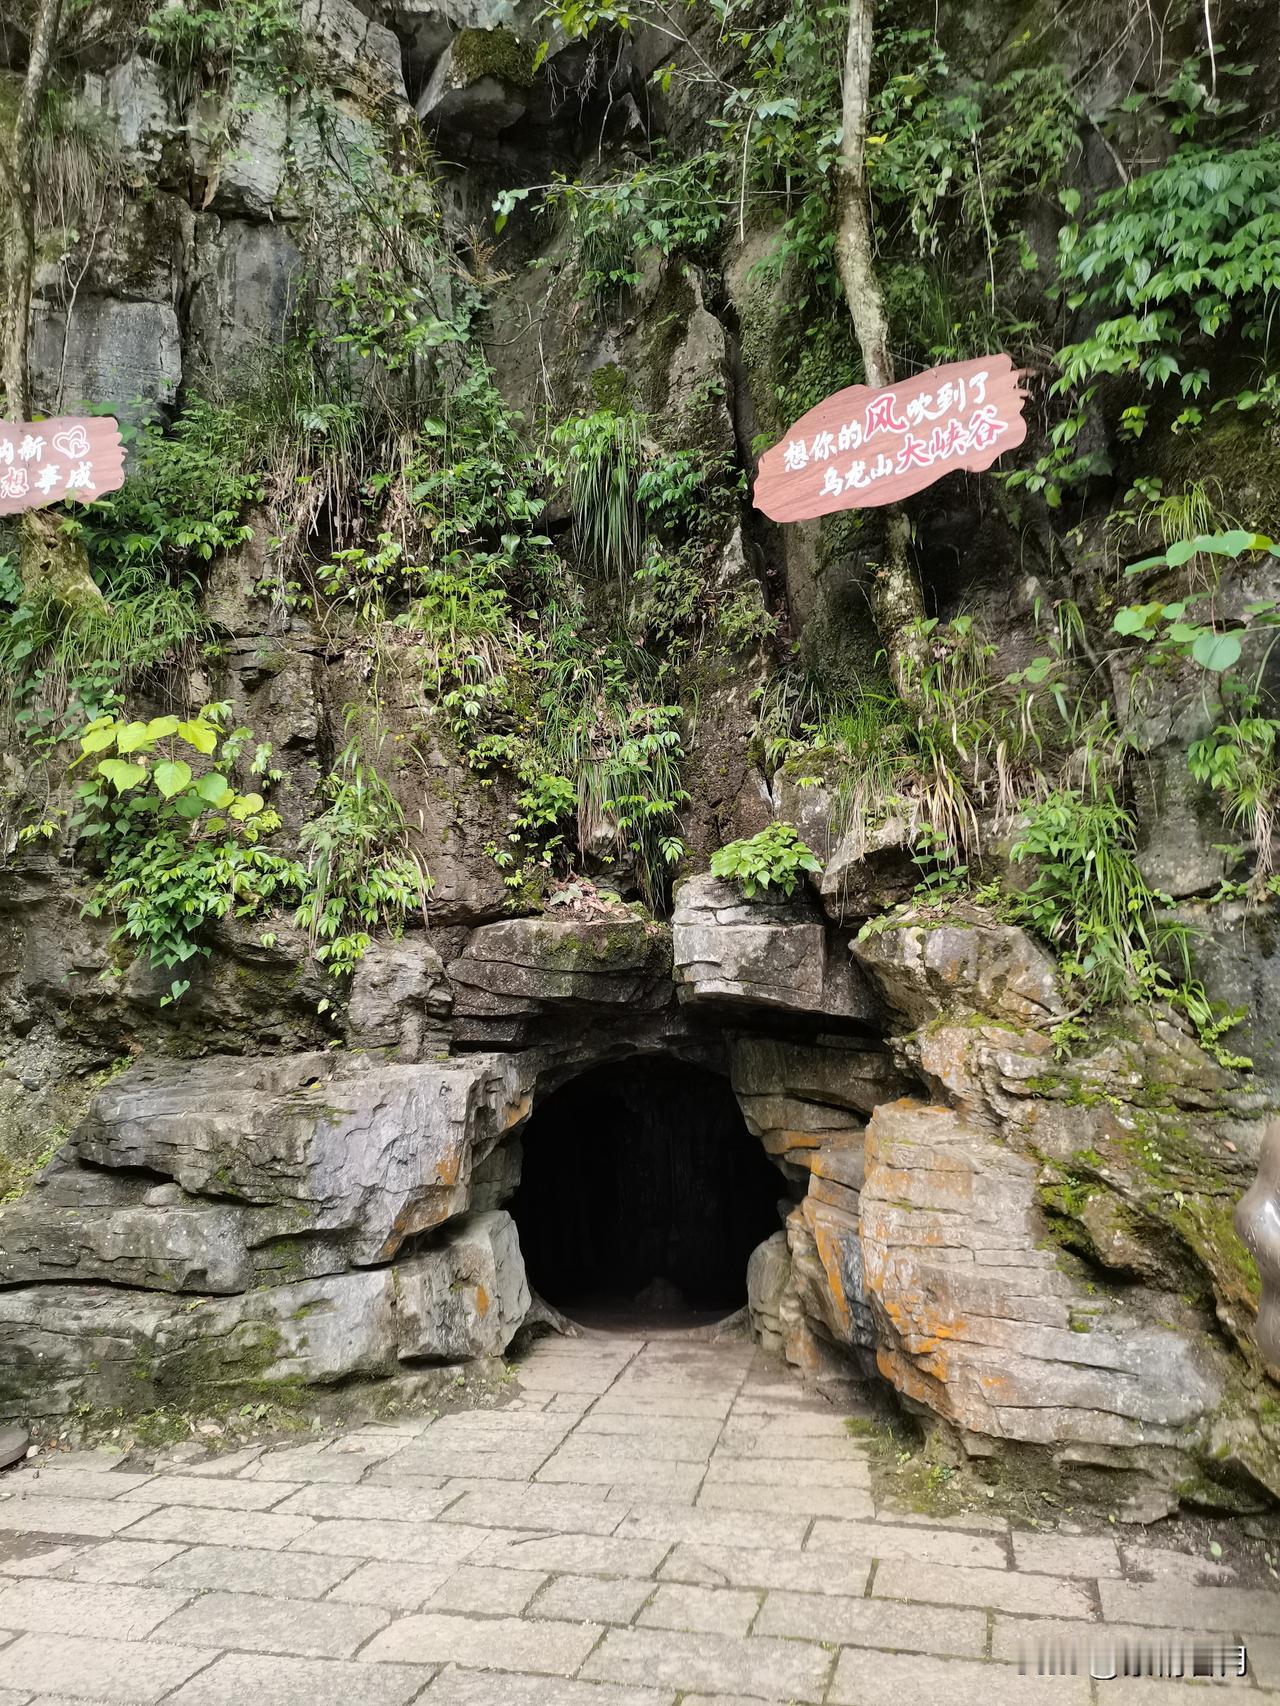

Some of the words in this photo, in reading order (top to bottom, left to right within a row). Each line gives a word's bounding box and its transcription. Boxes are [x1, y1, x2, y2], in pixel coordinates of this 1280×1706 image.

[784, 371, 988, 472] 想你的风吹到了
[820, 405, 1008, 496] 乌龙山大峡谷
